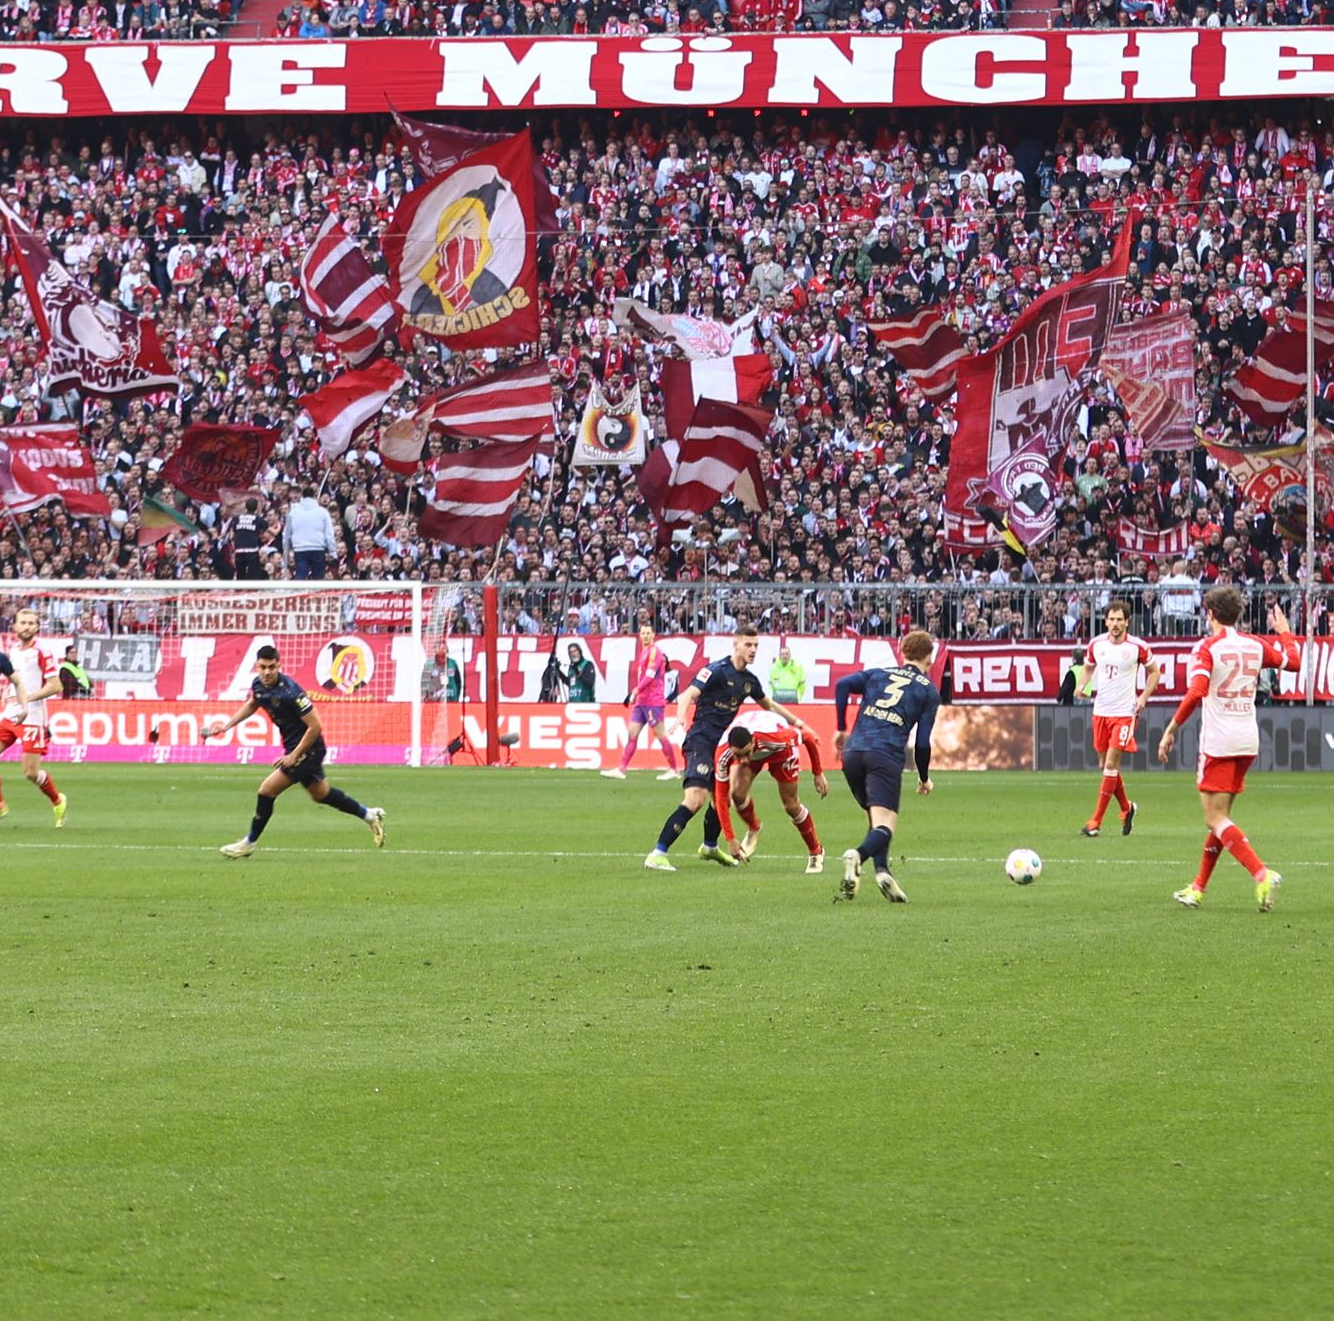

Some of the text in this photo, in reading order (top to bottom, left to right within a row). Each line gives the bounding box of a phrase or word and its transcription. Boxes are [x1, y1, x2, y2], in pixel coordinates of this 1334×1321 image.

[179, 613, 337, 632] IMMER BEI UNS
[1218, 653, 1259, 698] 25
[876, 673, 912, 709] 3
[1222, 700, 1254, 713] MÜLLER
[23, 728, 38, 743] 27
[1118, 725, 1129, 740] 8
